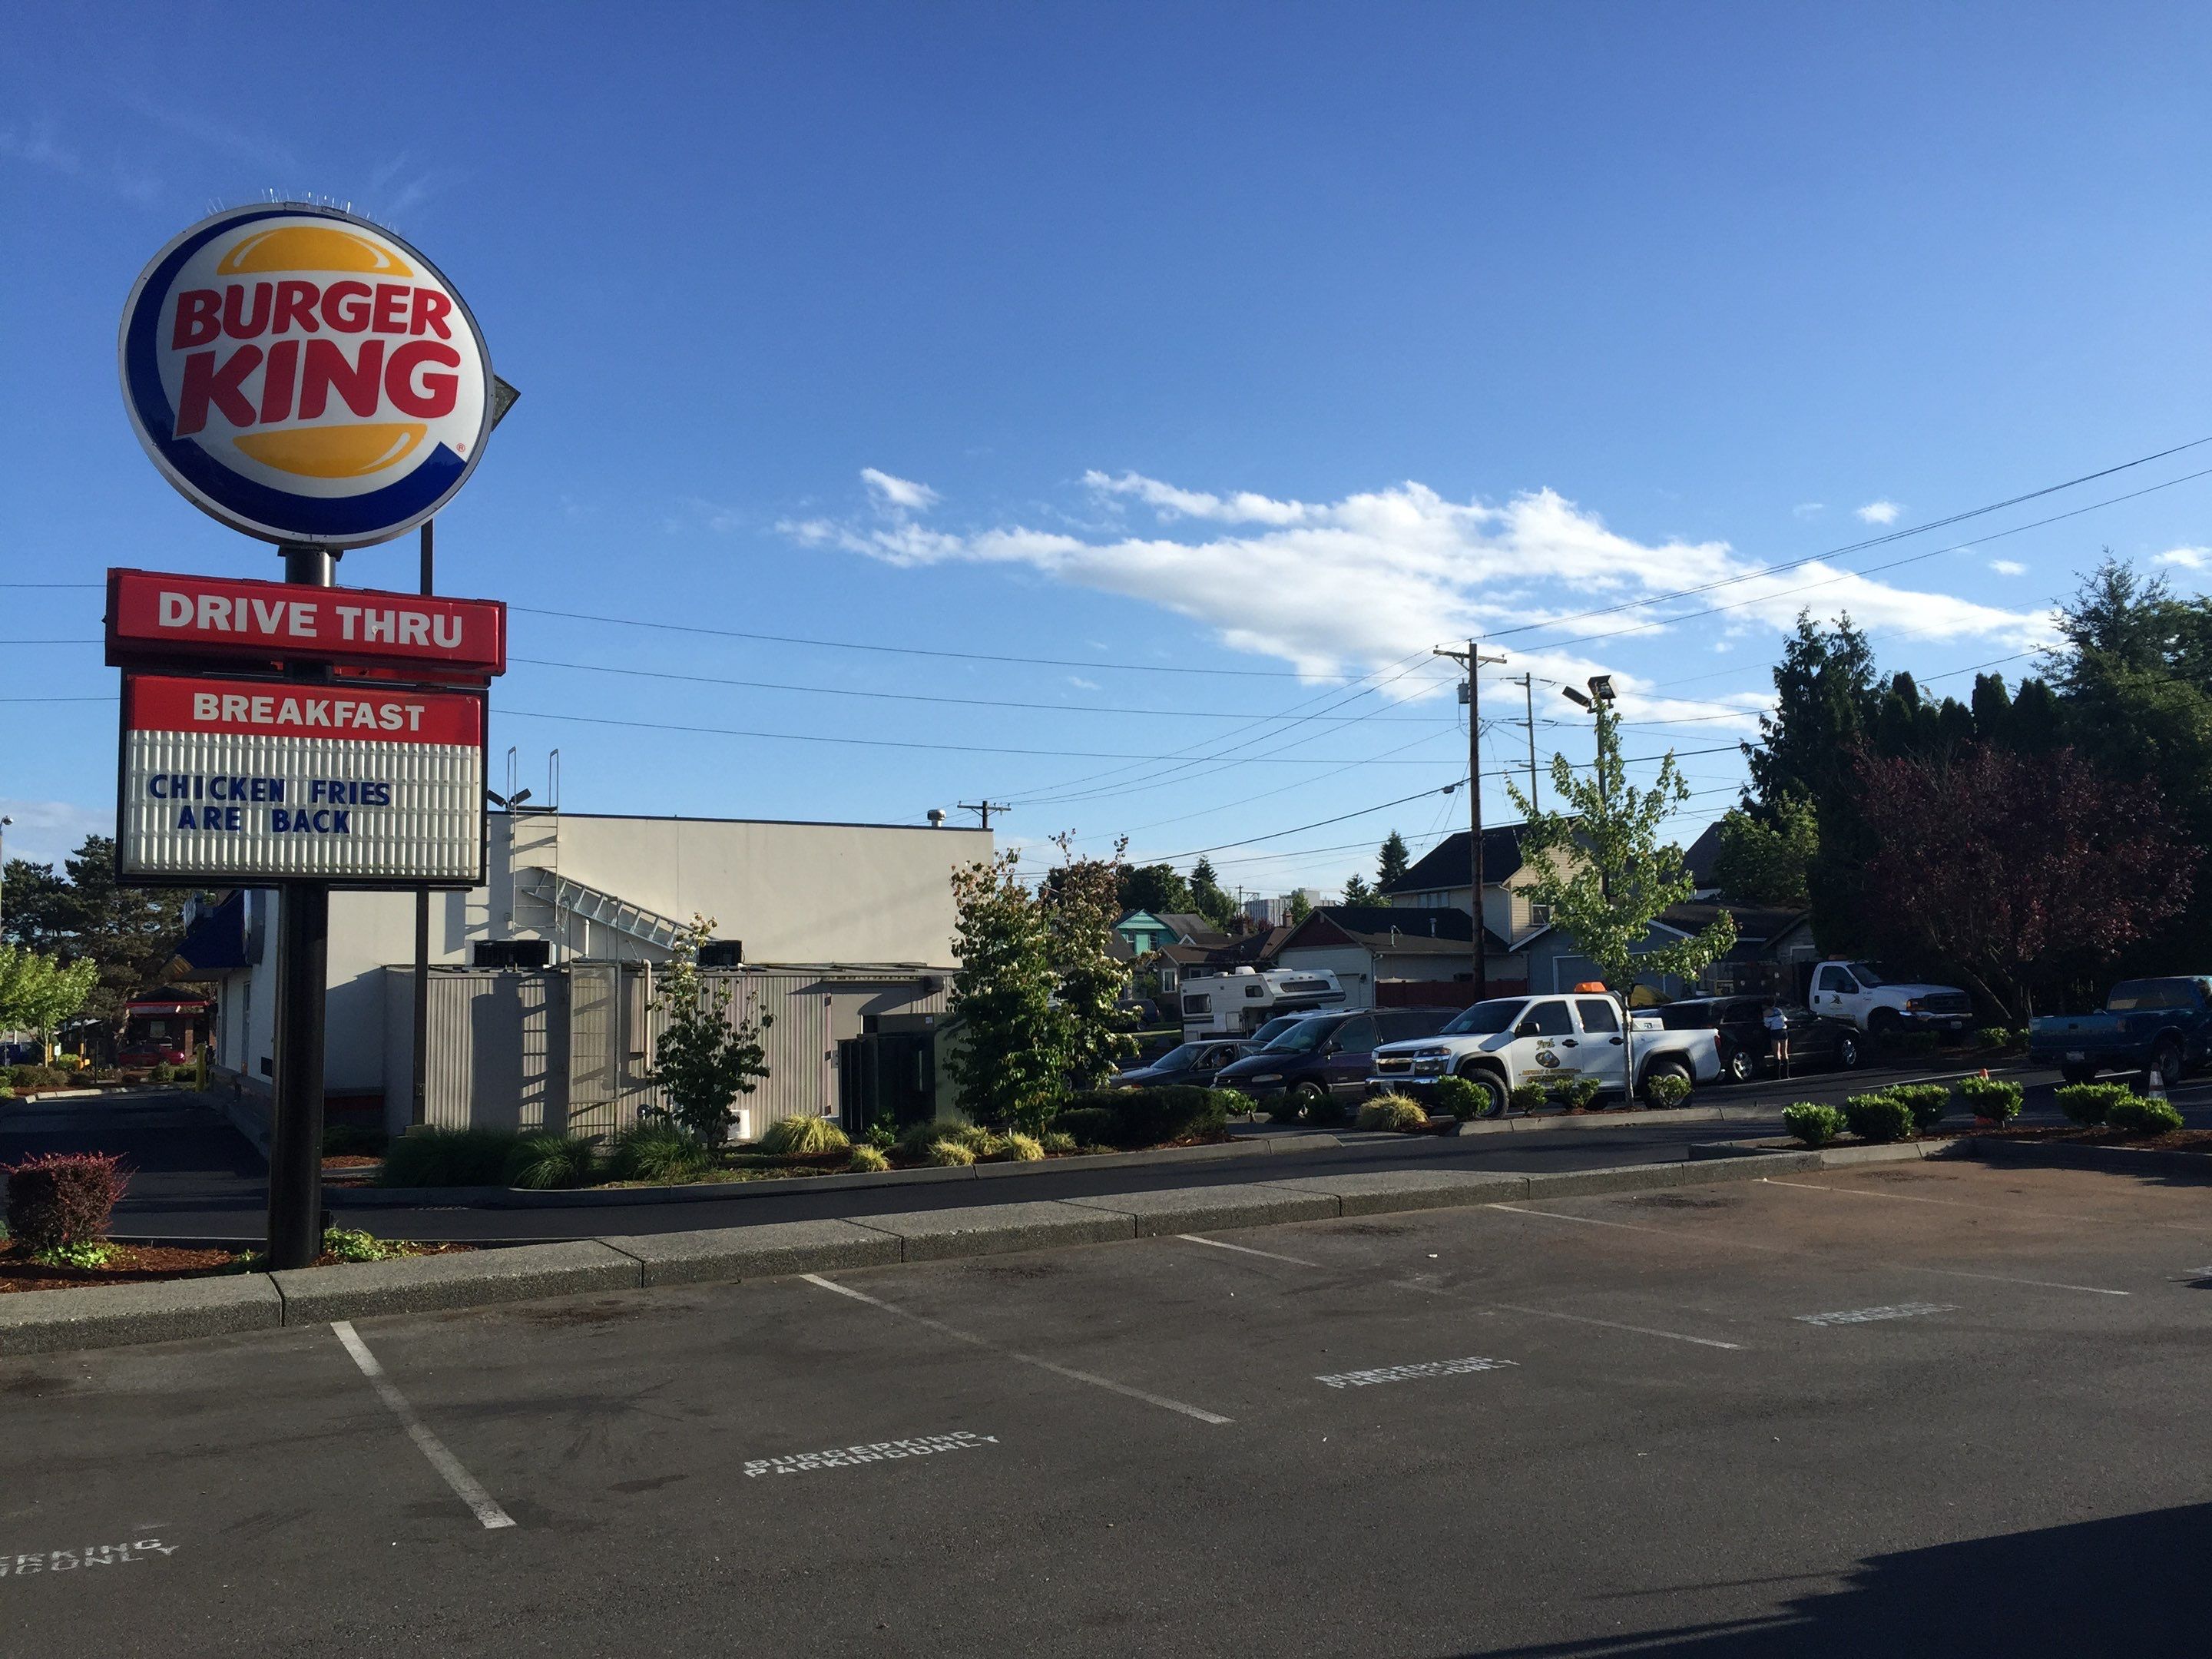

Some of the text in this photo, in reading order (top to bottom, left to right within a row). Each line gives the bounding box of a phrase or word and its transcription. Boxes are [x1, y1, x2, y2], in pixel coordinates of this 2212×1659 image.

[171, 280, 452, 350] BURGER
[176, 339, 461, 436] KING
[158, 591, 462, 648] DRIVE THRU
[193, 693, 425, 731] BREAKFAST
[149, 774, 390, 806] CHICKEN FRIES
[177, 805, 350, 833] ARE BACK
